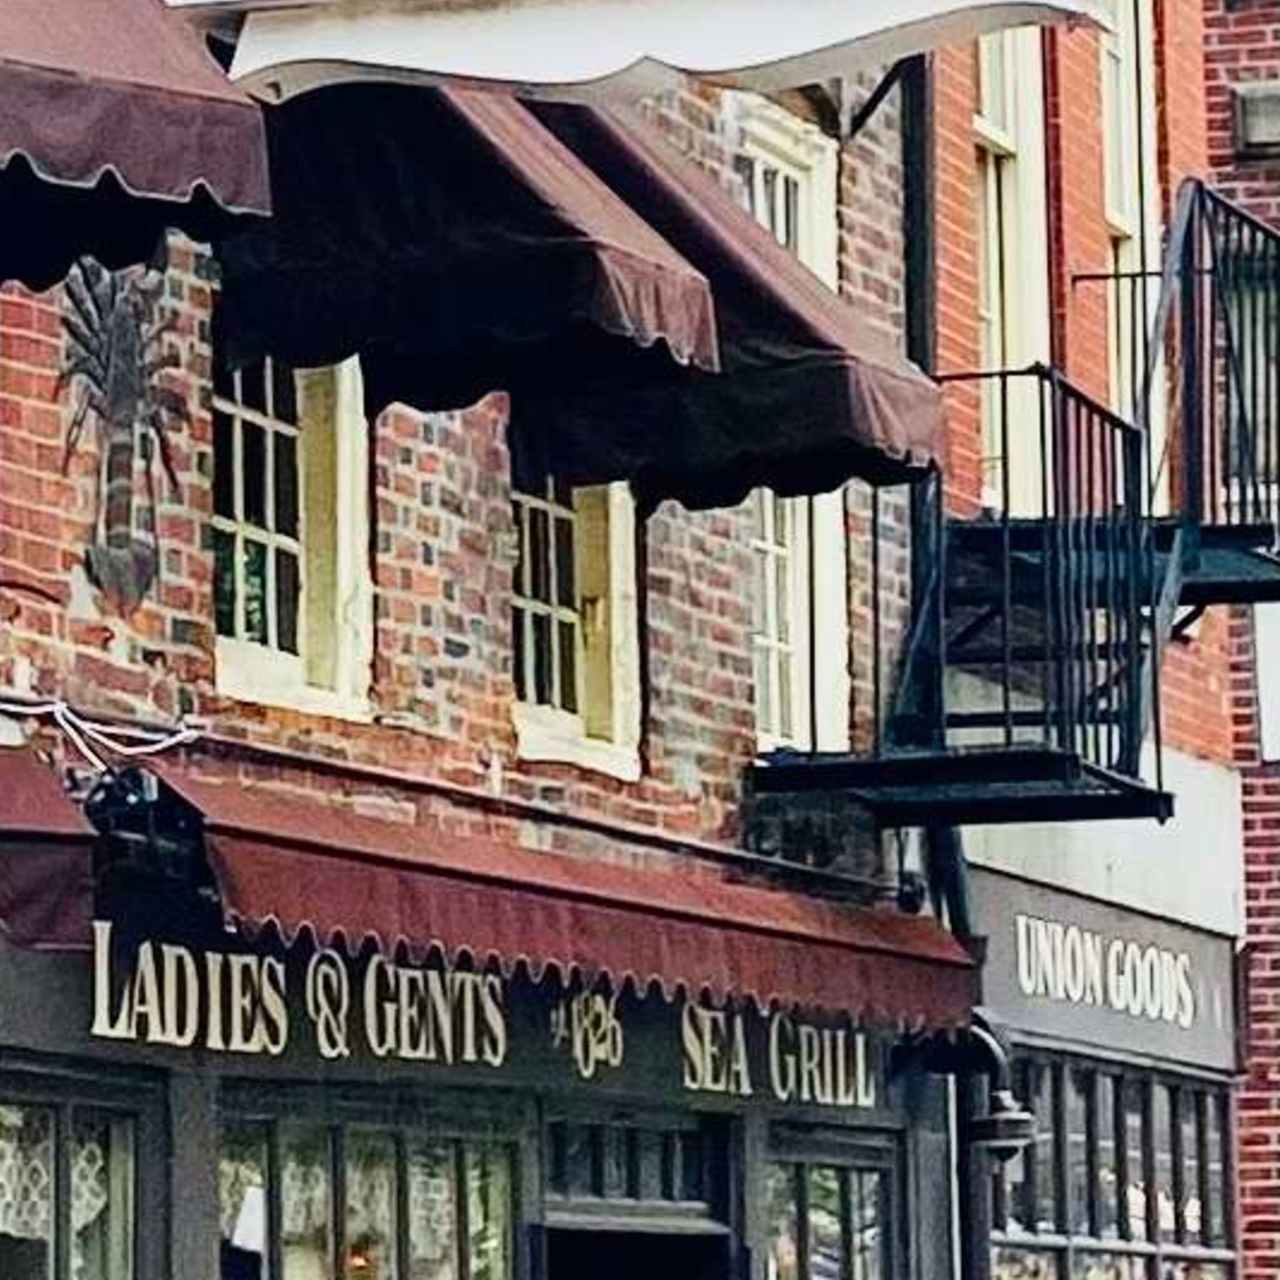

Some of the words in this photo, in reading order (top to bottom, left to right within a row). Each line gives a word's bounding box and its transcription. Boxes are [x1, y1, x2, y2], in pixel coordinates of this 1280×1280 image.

[91, 920, 288, 1056] LADIES
[306, 949, 350, 1059] &
[364, 953, 507, 1067] GENTS
[1015, 915, 1103, 1006] UNION
[1107, 939, 1194, 1029] GOODS
[682, 1002, 753, 1096] SEA
[770, 1011, 876, 1108] GRILL
